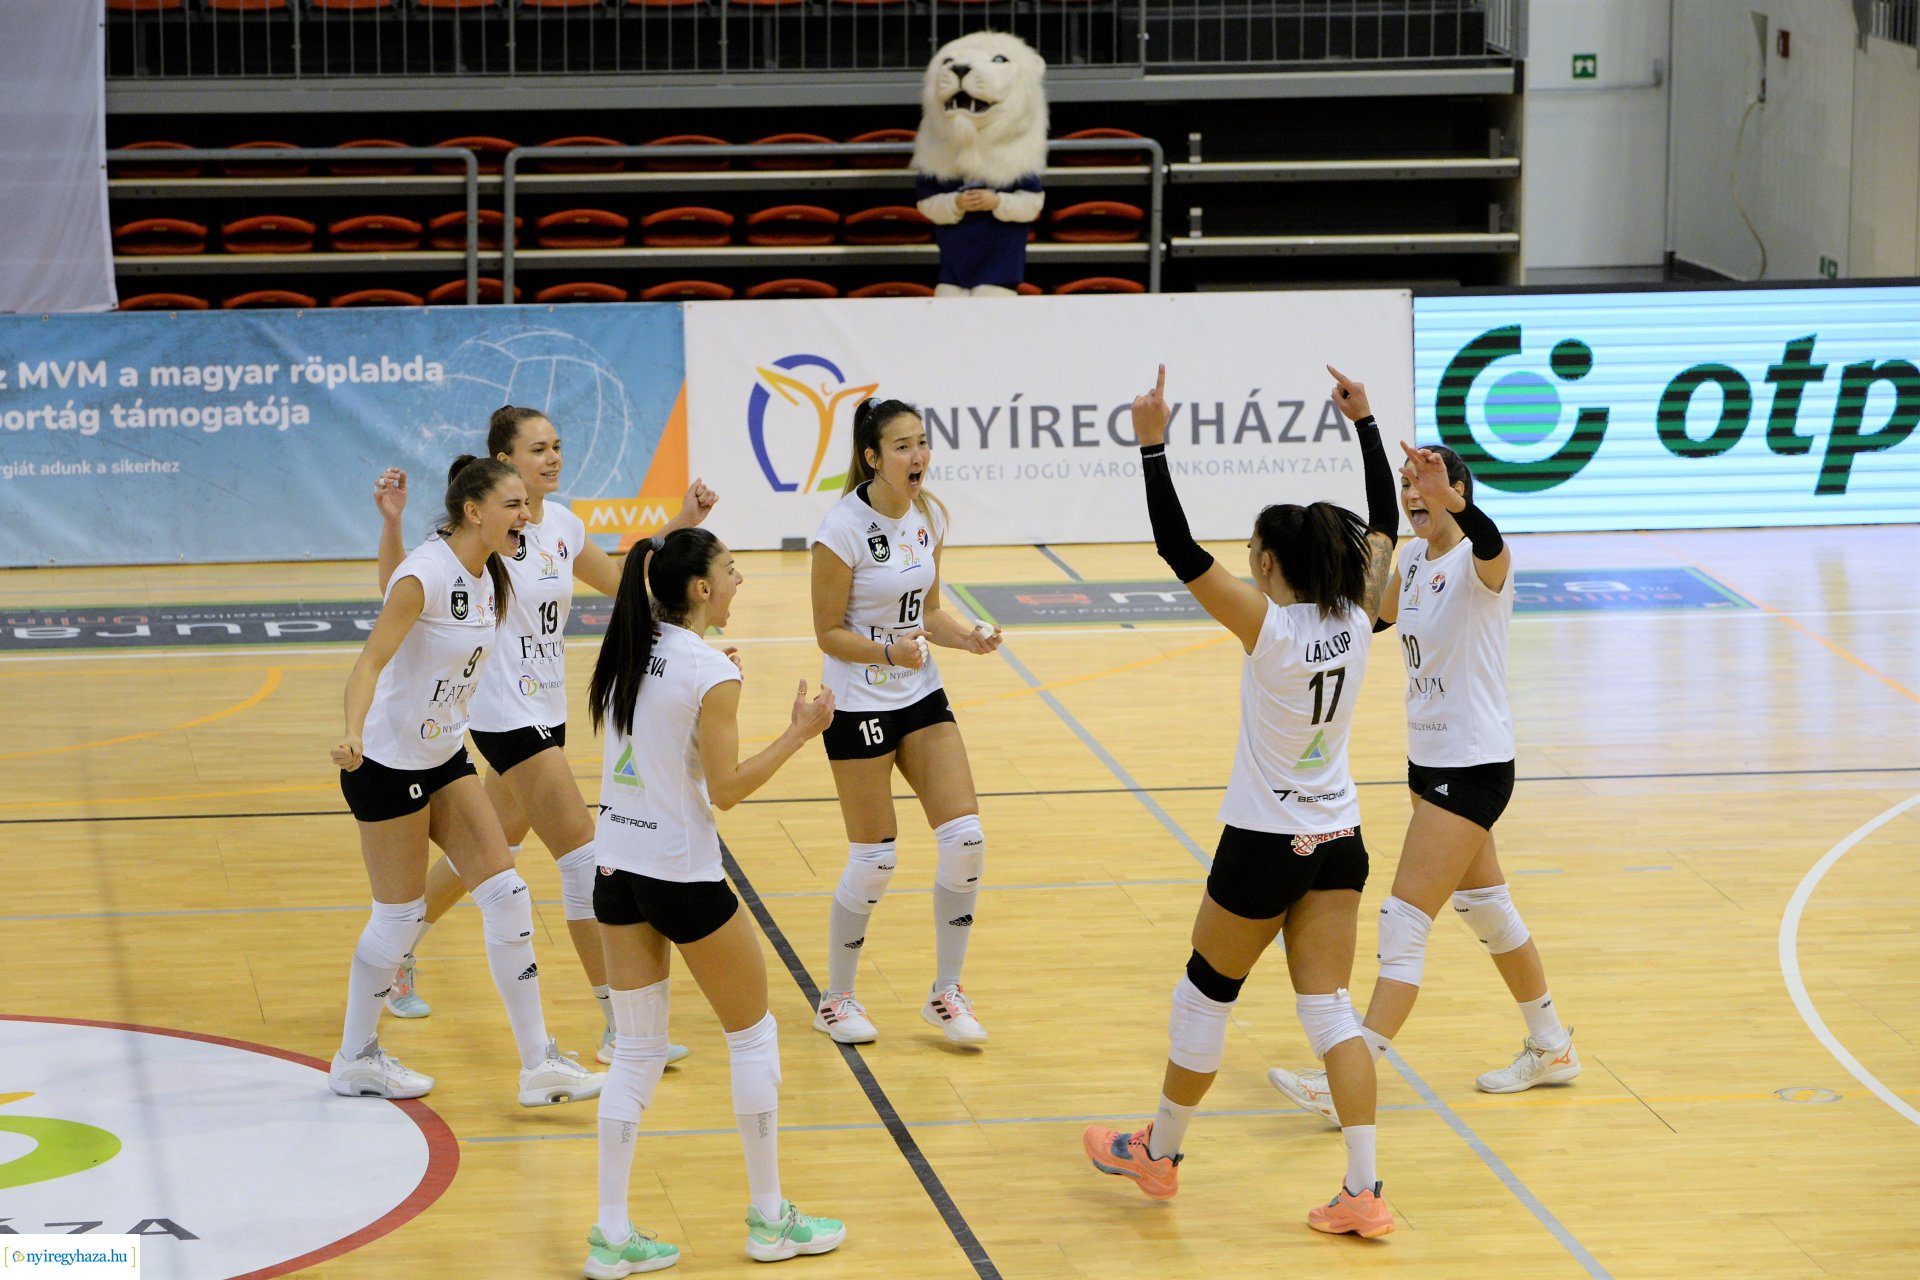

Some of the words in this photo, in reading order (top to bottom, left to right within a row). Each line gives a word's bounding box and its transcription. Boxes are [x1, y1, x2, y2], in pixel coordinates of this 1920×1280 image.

[18, 359, 108, 390] MVM
[118, 366, 140, 388] a
[150, 364, 281, 392] magyar
[289, 354, 444, 390] röplabda
[0, 399, 100, 436] ortág
[110, 395, 311, 433] támogatója
[1656, 332, 1920, 496] otp
[40, 459, 93, 476] adunk
[96, 463, 107, 475] a
[111, 458, 181, 475] sikerhez
[925, 464, 1005, 481] MEGYEI
[1014, 459, 1071, 481] JOGÚ
[588, 503, 670, 527] MVM
[538, 600, 558, 635] 19
[897, 588, 923, 623] 15
[462, 646, 483, 679] 9
[1402, 633, 1421, 670] 10
[1308, 666, 1346, 726] 17
[858, 717, 885, 747] 15
[610, 813, 658, 830] BESTRONG
